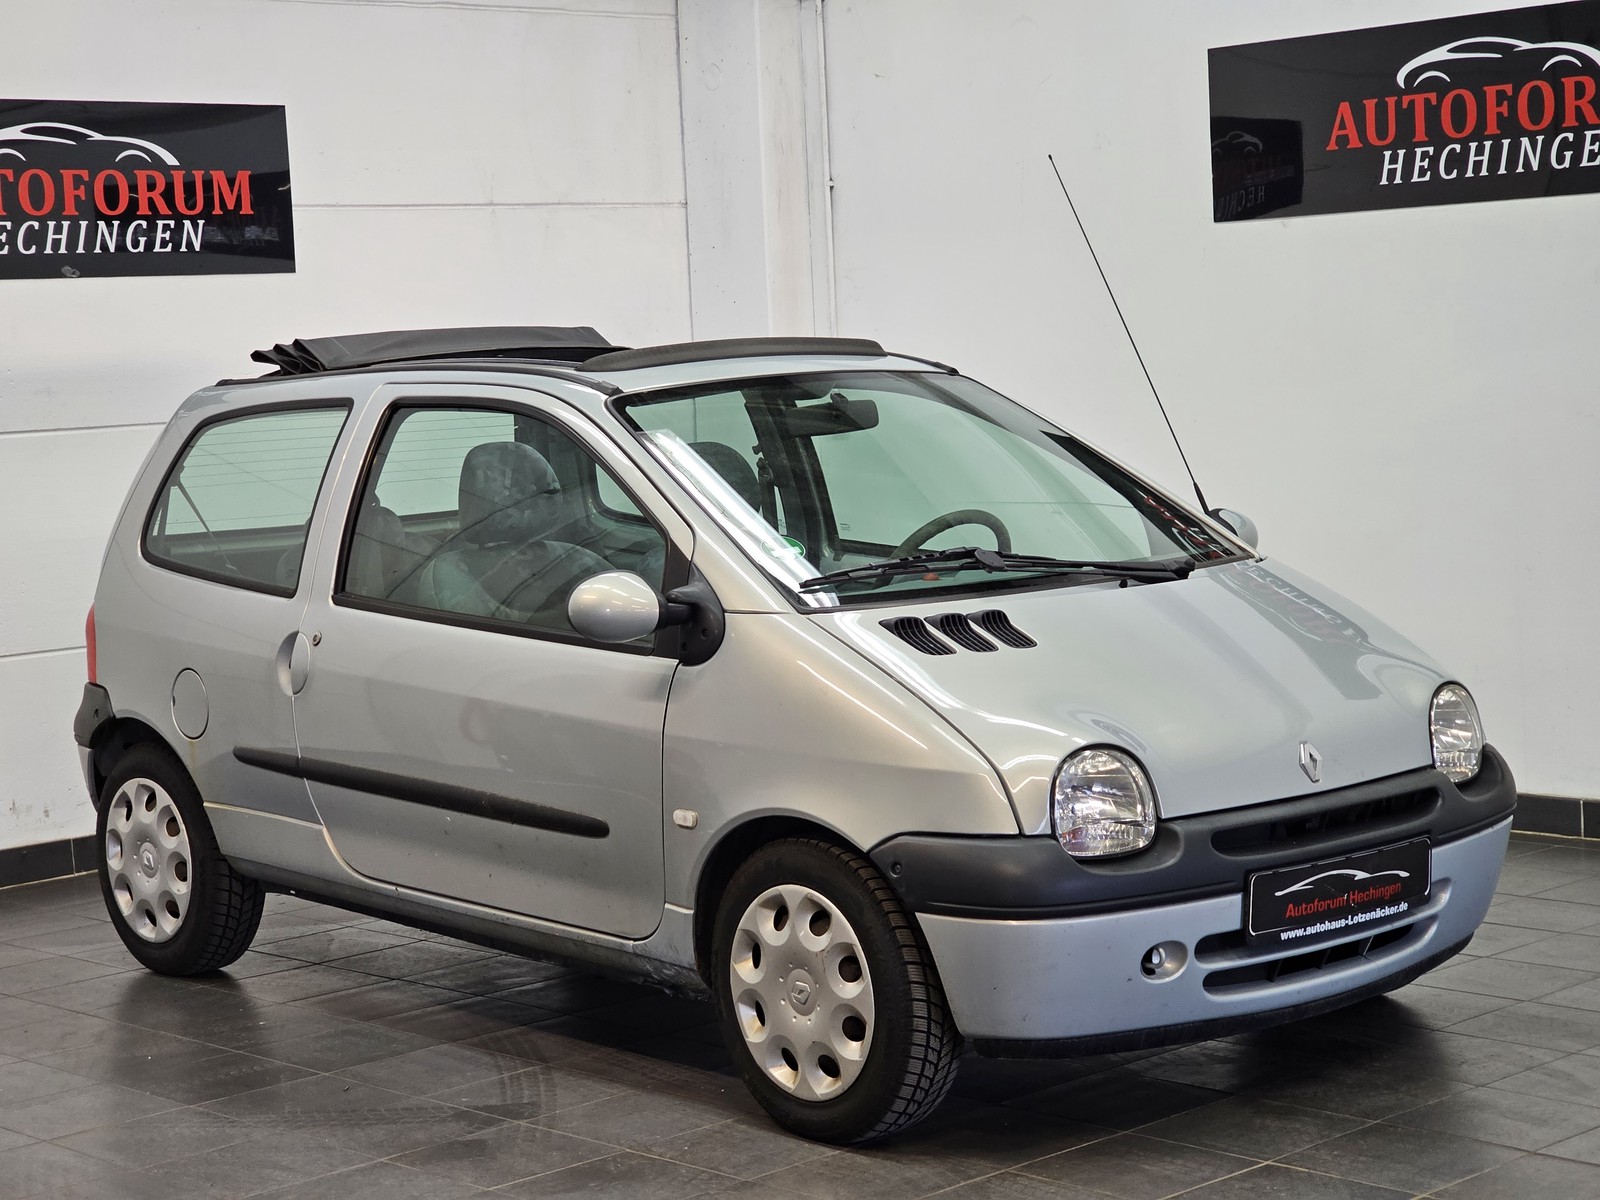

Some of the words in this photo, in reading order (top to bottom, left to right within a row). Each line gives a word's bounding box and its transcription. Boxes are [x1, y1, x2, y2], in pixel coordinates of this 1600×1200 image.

[1327, 76, 1600, 150] AUTOFOR
[1379, 130, 1600, 185] HECHINGE
[1281, 902, 1408, 940] www.autohaus-Lotzenäcker.de
[1286, 896, 1346, 918] Autoforum
[1350, 882, 1401, 903] Hechingen
